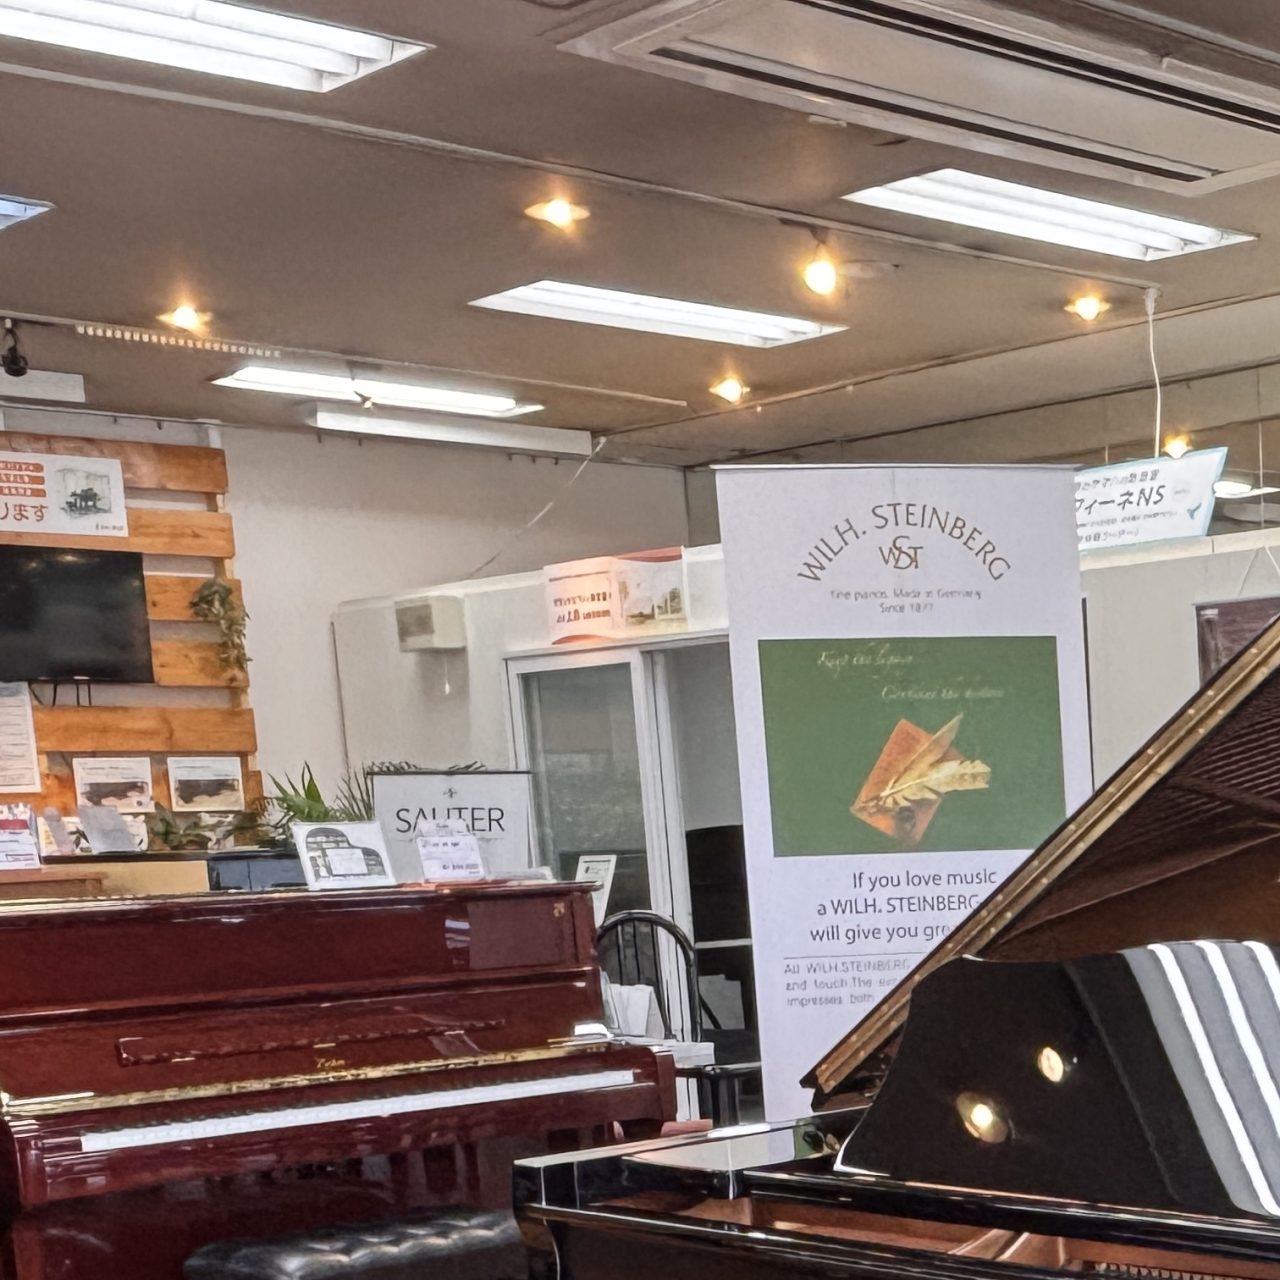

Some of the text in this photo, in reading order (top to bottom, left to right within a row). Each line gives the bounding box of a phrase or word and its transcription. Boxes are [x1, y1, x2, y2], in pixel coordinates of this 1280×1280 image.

[797, 502, 1011, 582] WILH. STEINBERG
[853, 868, 997, 892] If you love music
[817, 903, 827, 916] a
[831, 897, 883, 915] WILH.
[810, 925, 840, 942] will
[845, 924, 881, 945] give
[886, 926, 919, 943] you
